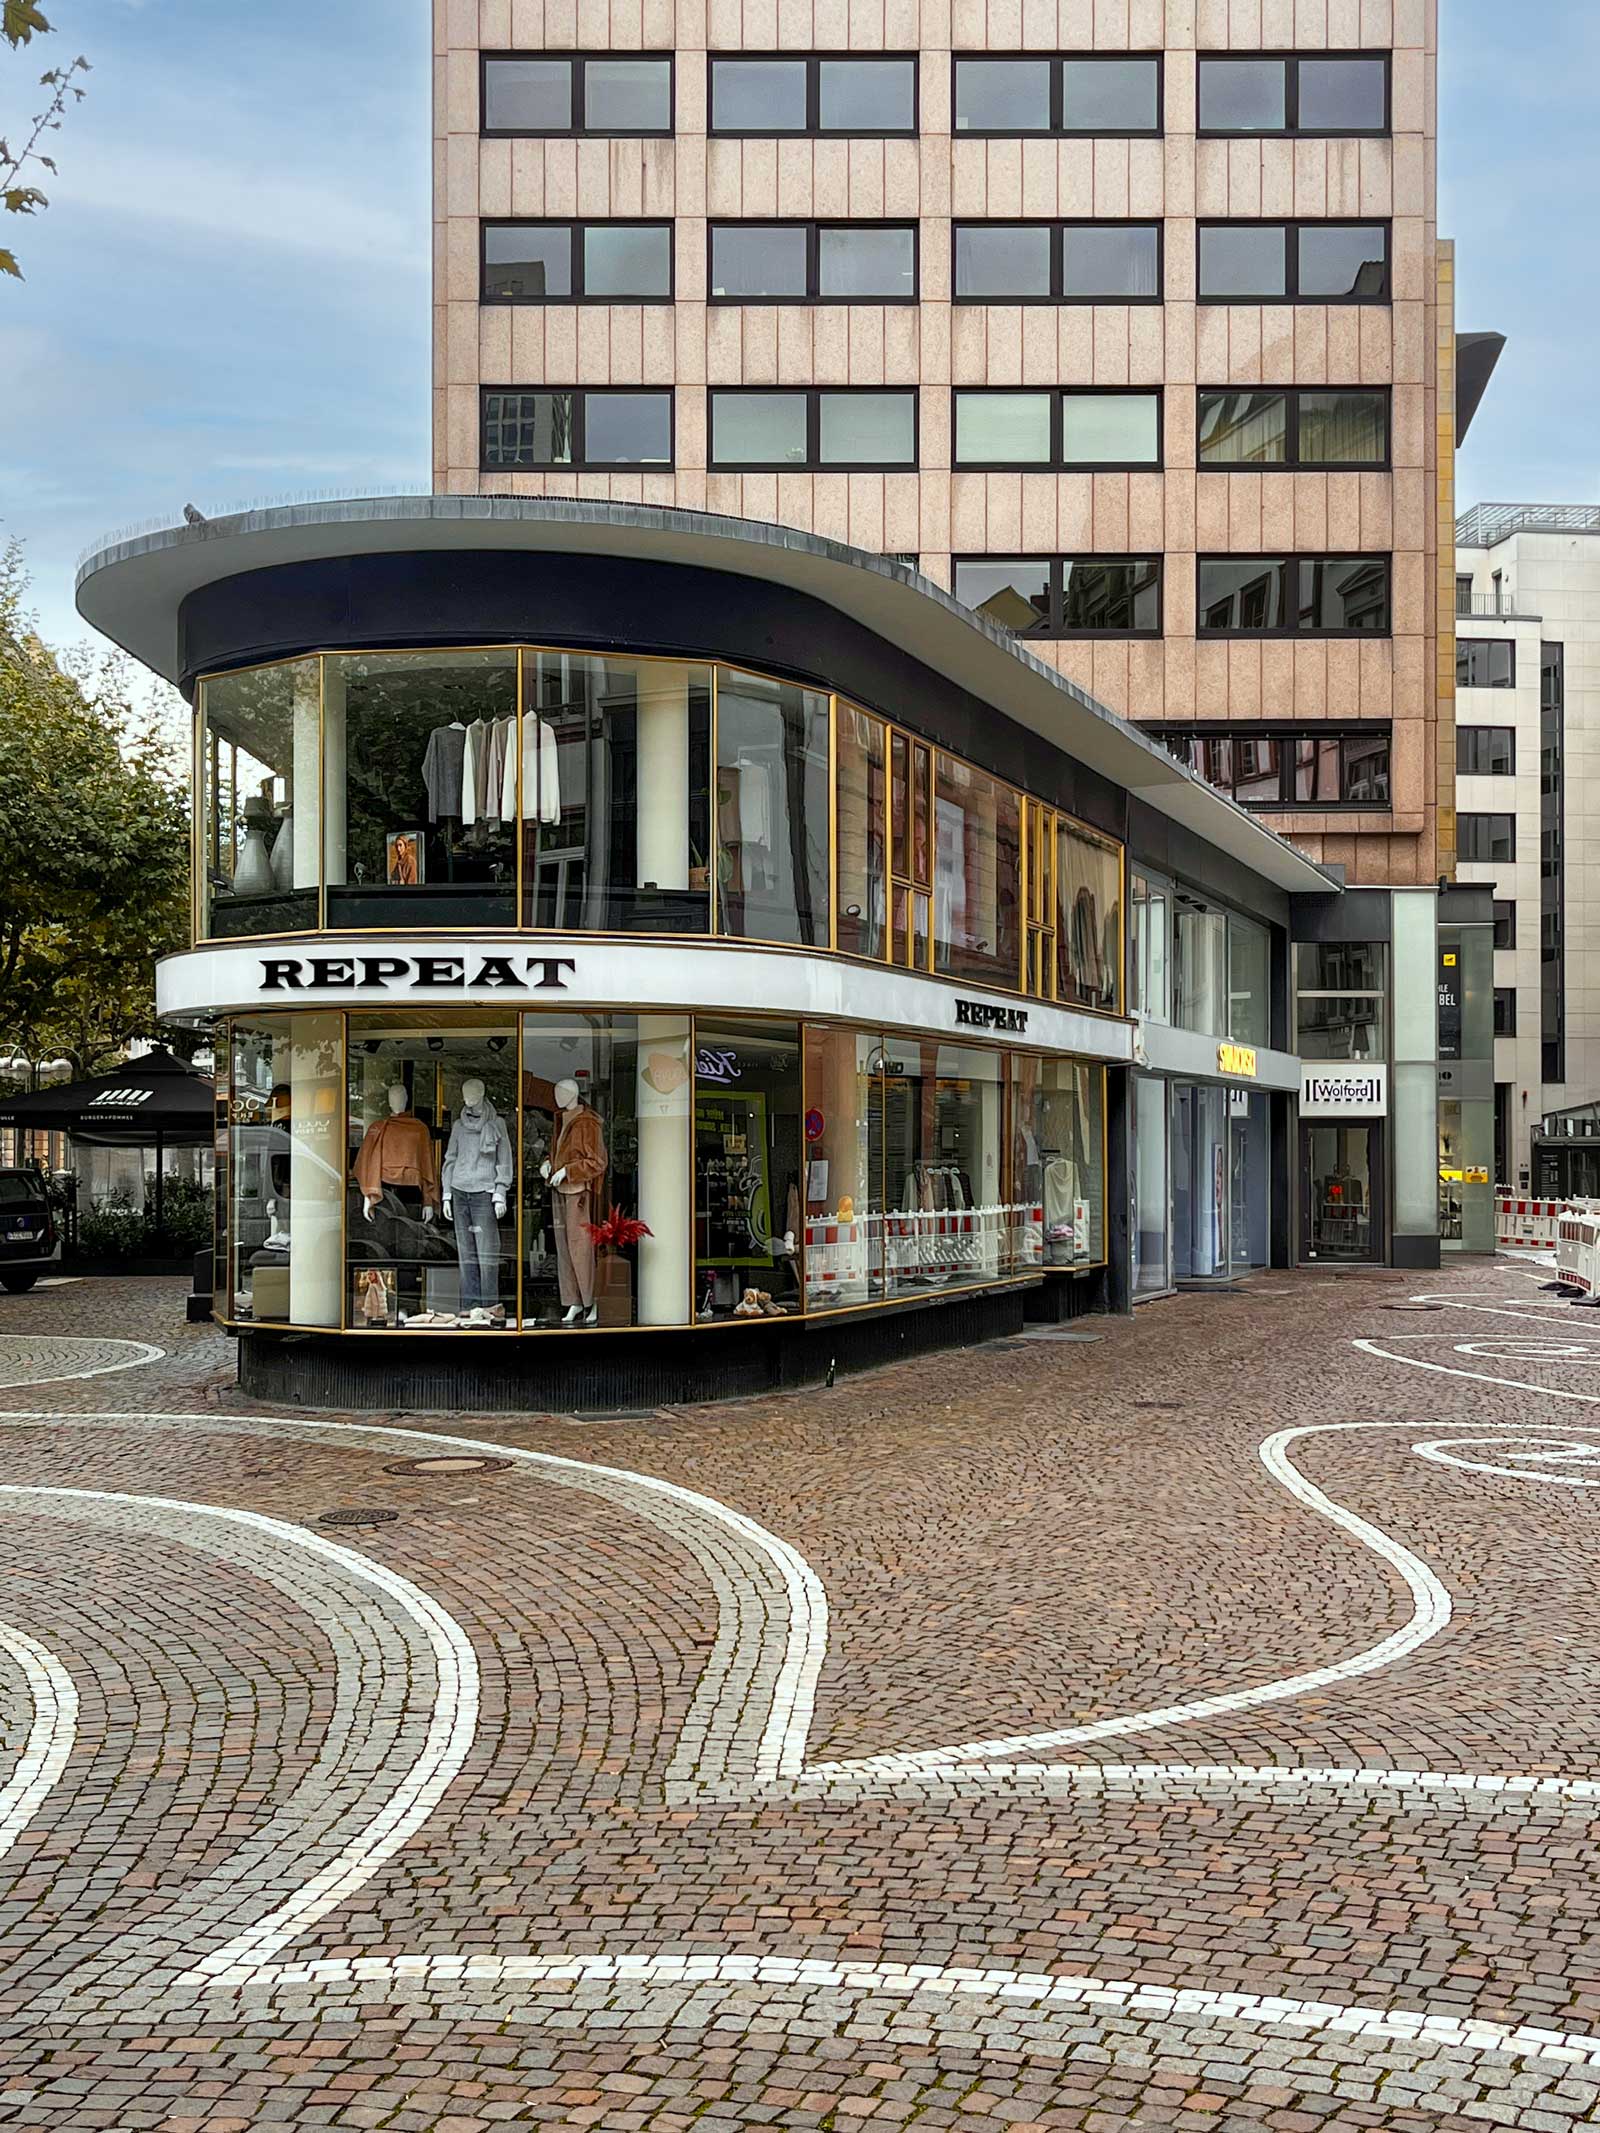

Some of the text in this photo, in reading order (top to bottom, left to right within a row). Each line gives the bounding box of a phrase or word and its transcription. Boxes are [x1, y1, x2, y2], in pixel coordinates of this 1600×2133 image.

[258, 957, 576, 989] REPEAT
[954, 998, 1029, 1033] REPEAT
[1318, 1083, 1368, 1098] Wolford
